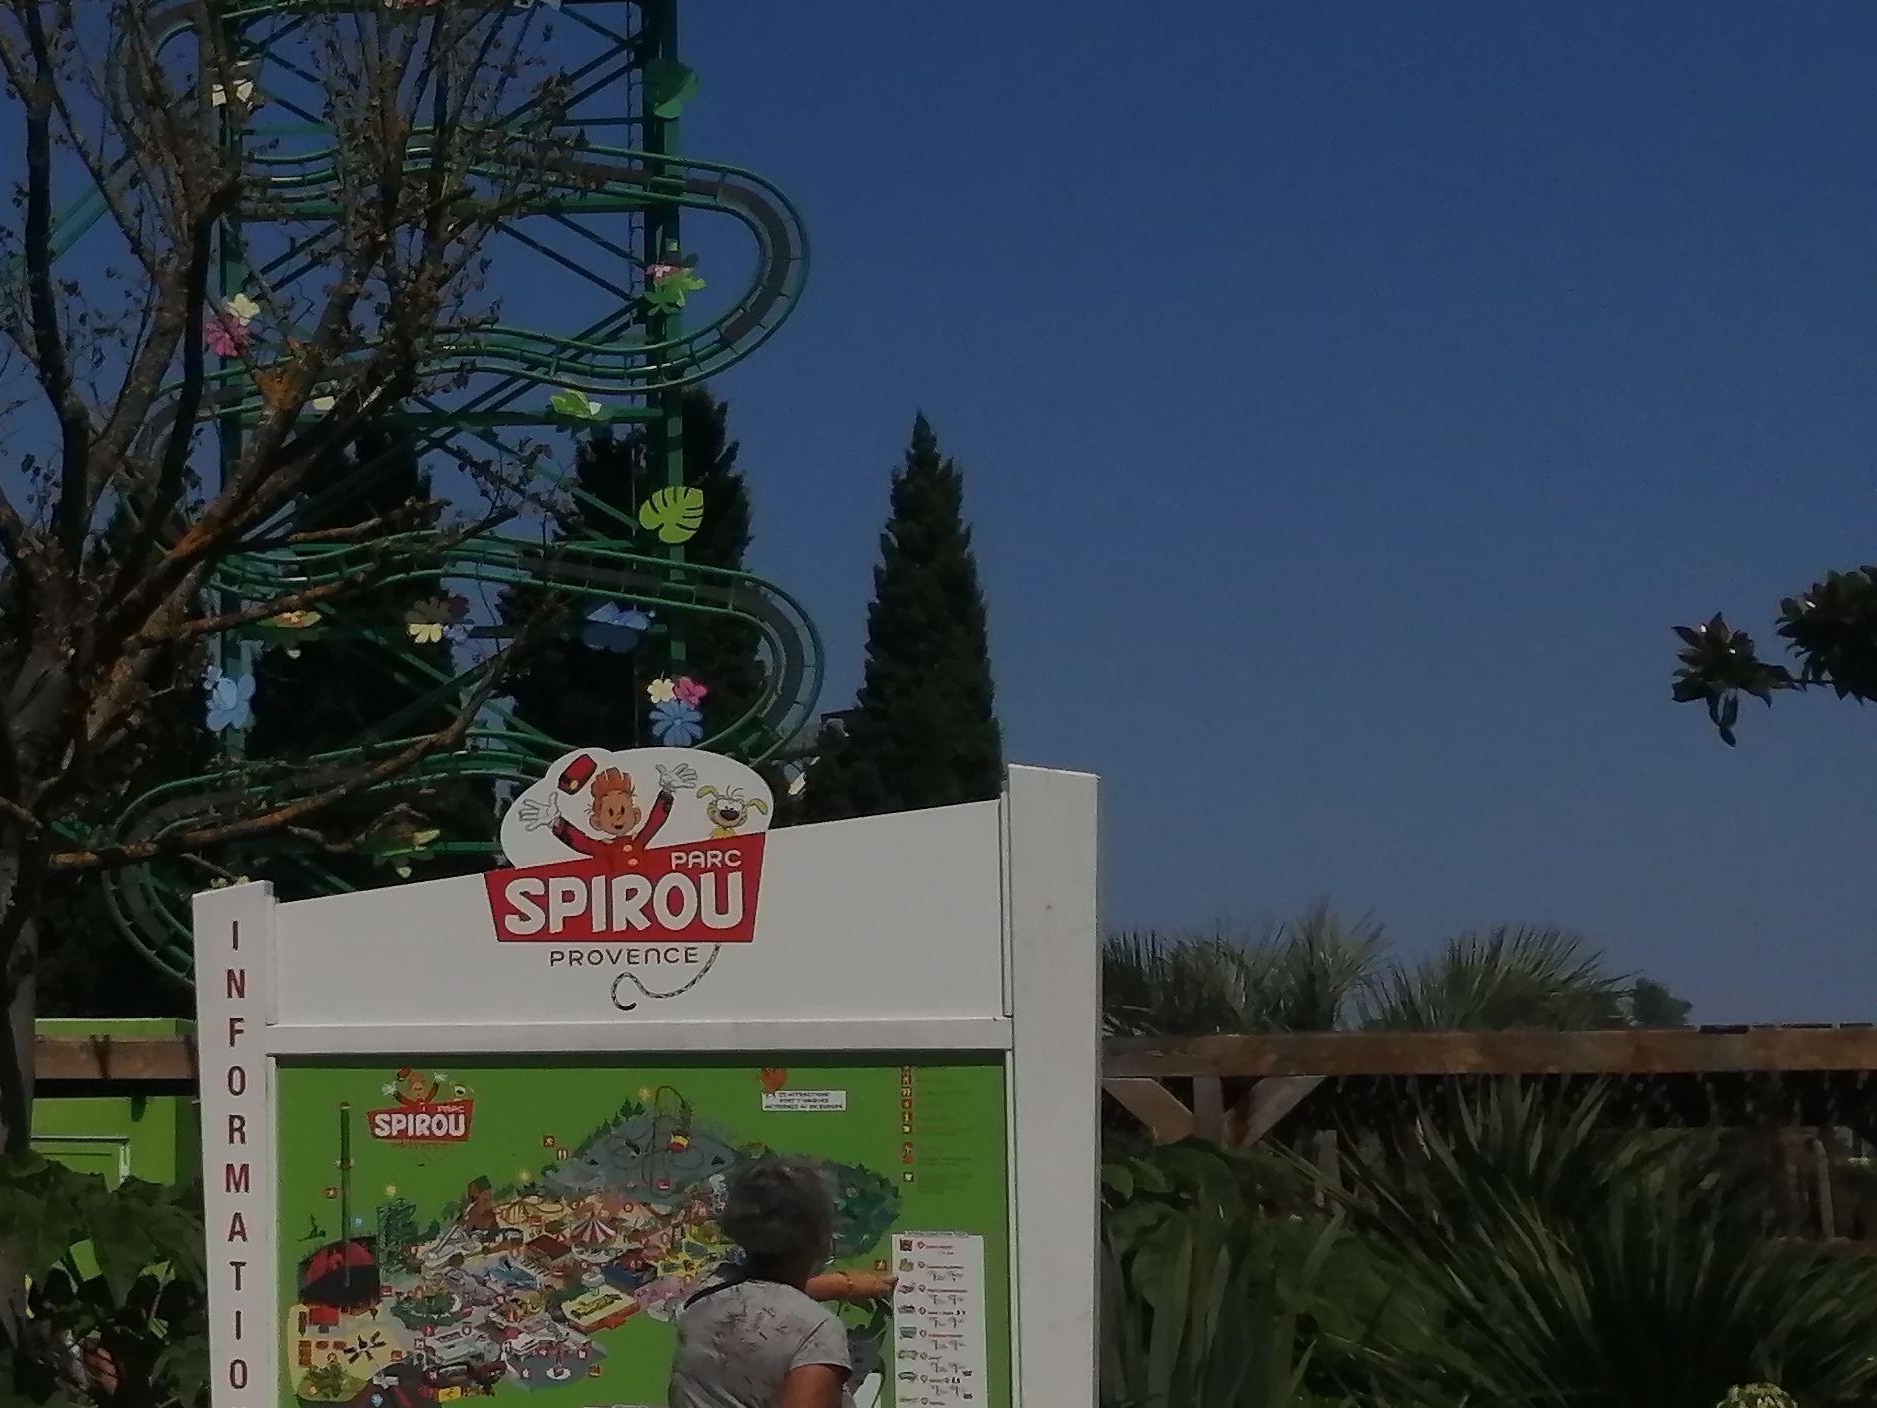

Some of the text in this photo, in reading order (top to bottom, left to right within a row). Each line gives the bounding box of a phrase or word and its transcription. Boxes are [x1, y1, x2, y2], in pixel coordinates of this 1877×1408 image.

[670, 850, 743, 870] PARC
[504, 871, 744, 935] SPIROU
[549, 947, 700, 967] PROVENCE
[374, 1113, 466, 1137] SPIROU
